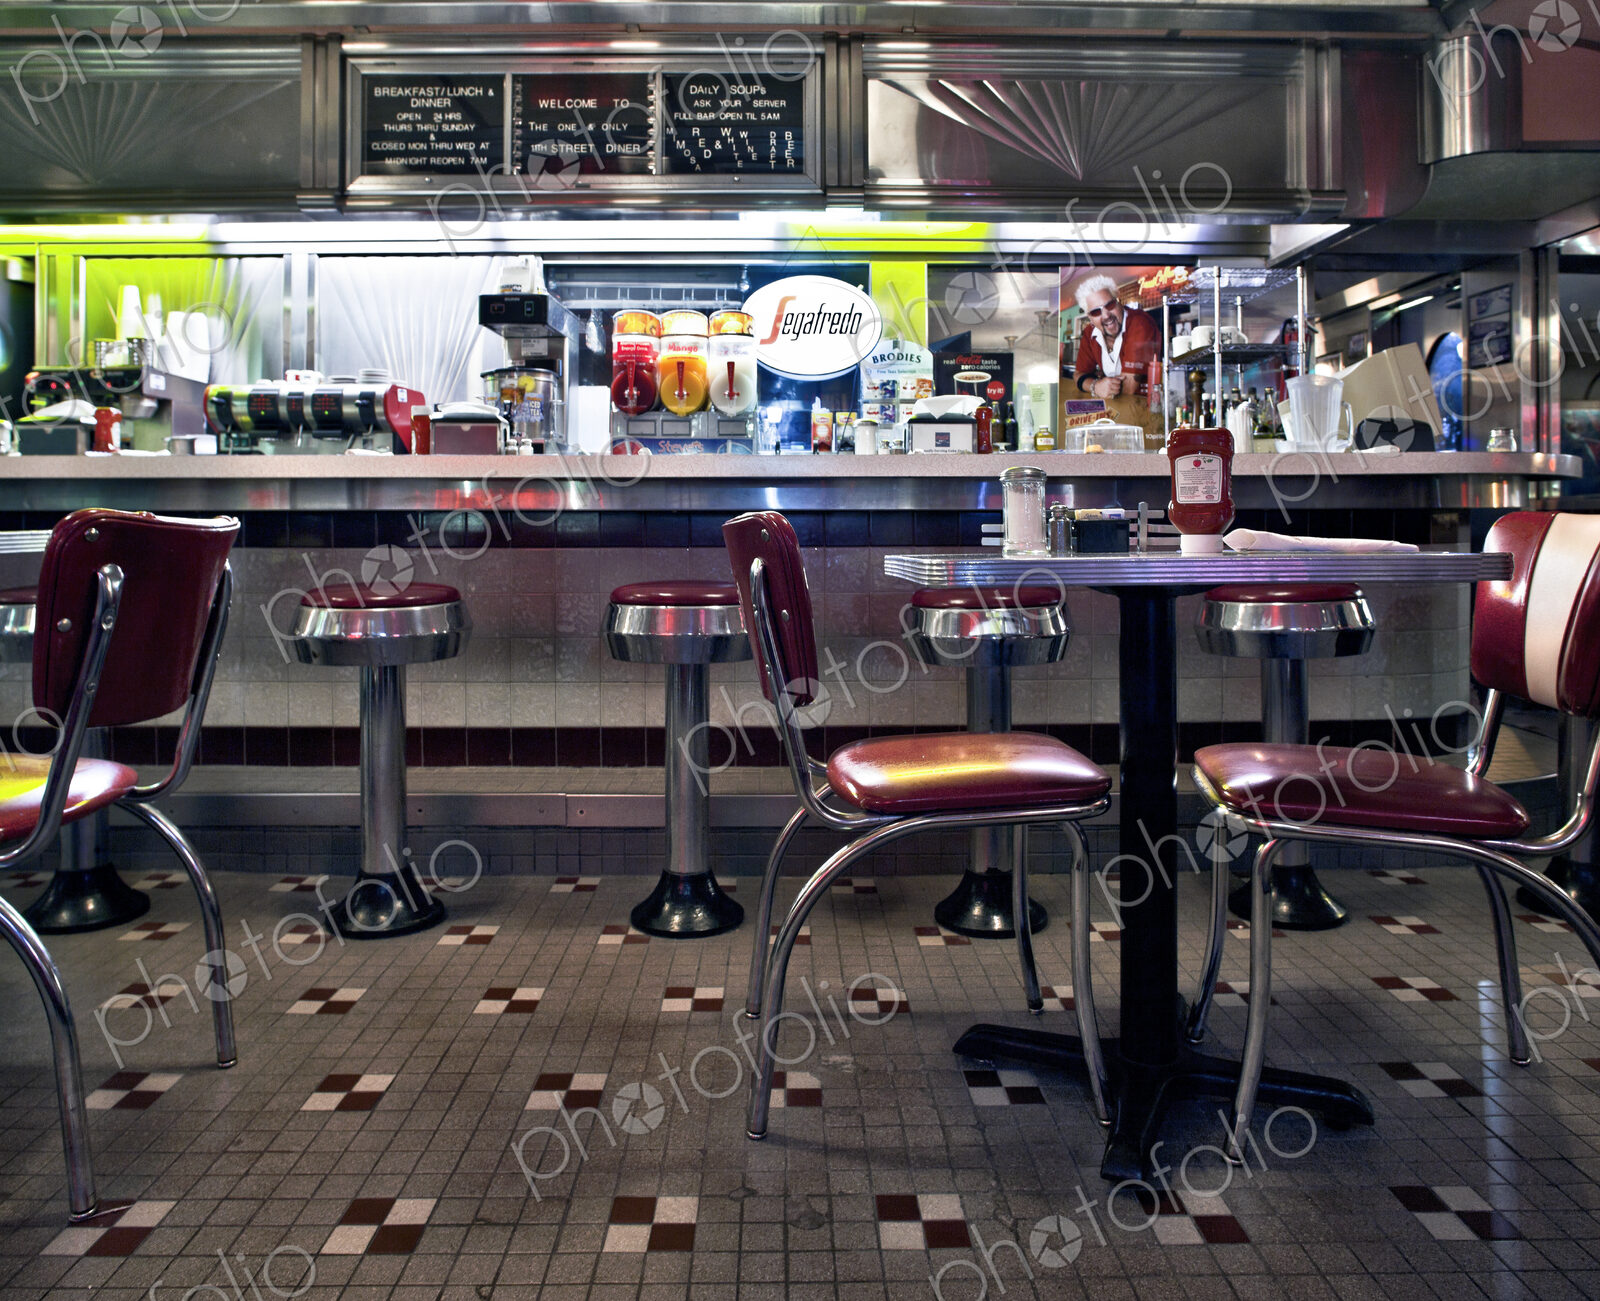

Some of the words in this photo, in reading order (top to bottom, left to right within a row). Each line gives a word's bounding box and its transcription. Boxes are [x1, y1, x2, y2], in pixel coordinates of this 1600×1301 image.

[488, 88, 494, 96] &
[410, 98, 451, 108] DINNER
[538, 98, 598, 109] WELCOME
[613, 98, 630, 108] TO
[693, 99, 711, 107] ASK
[719, 99, 742, 107] YOUR
[752, 99, 787, 107] SERVER
[397, 112, 422, 121] OPEN
[444, 112, 462, 121] HRS
[674, 112, 693, 120] FULL
[696, 112, 715, 120] BAR
[719, 112, 743, 120] OPEN
[745, 112, 757, 120] TIL
[760, 112, 780, 120] 5AM
[383, 123, 412, 132] THURS
[416, 123, 439, 132] THRU
[441, 123, 475, 132] SUNDAY
[557, 123, 577, 132] ONE
[587, 123, 595, 131] &
[601, 122, 628, 132] ONLY
[429, 133, 436, 141] &
[371, 142, 405, 150] CLOSED
[408, 142, 427, 150] MON
[430, 142, 453, 150] THRU
[455, 142, 475, 150] WED
[479, 142, 490, 150] AT
[550, 143, 595, 153] STREET
[606, 143, 641, 153] DINER
[666, 127, 702, 171] MIMOSA
[692, 127, 712, 159] RED
[714, 140, 722, 150] &
[720, 127, 743, 168] WHITE
[739, 130, 758, 161] WINE
[769, 131, 777, 170] DRAFT
[784, 131, 795, 168] BEER
[384, 156, 427, 165] MIDNIGHT
[430, 156, 465, 165] REOPEN
[469, 156, 487, 165] 7AM
[759, 295, 863, 345] Segafredo
[668, 343, 698, 353] Mango
[871, 352, 922, 364] BRODIES
[987, 388, 997, 396] try
